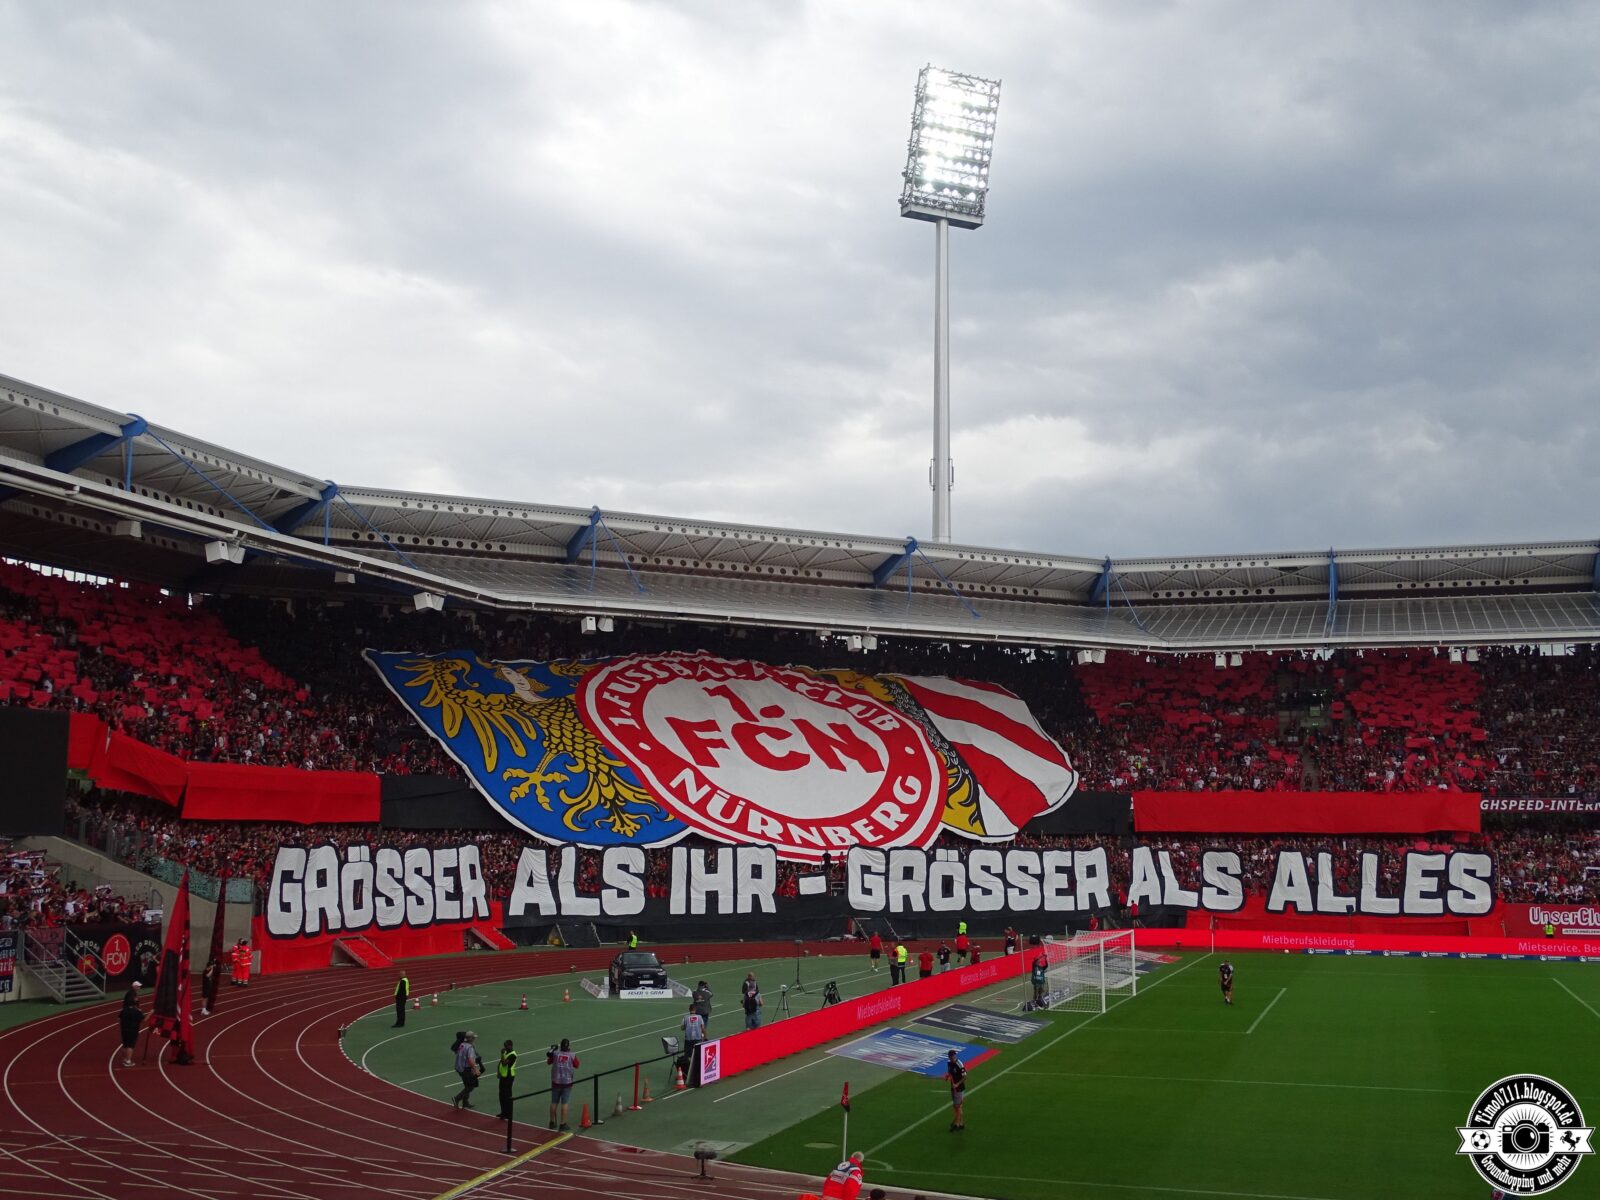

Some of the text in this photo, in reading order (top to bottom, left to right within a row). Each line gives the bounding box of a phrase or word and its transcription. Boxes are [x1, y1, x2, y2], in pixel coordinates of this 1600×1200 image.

[665, 714, 886, 774] FCN
[669, 768, 923, 848] NÜRNBERG
[267, 844, 490, 935] GRÖSSER
[508, 846, 646, 917] ALS
[669, 846, 777, 915] IHR
[848, 846, 1110, 912] GRÖSSER
[1126, 846, 1245, 911] ALS
[1267, 850, 1492, 914] ALLES
[106, 952, 127, 965] FCN
[1262, 935, 1355, 948] Mietberufskleidung
[1518, 942, 1581, 953] Mietservice.
